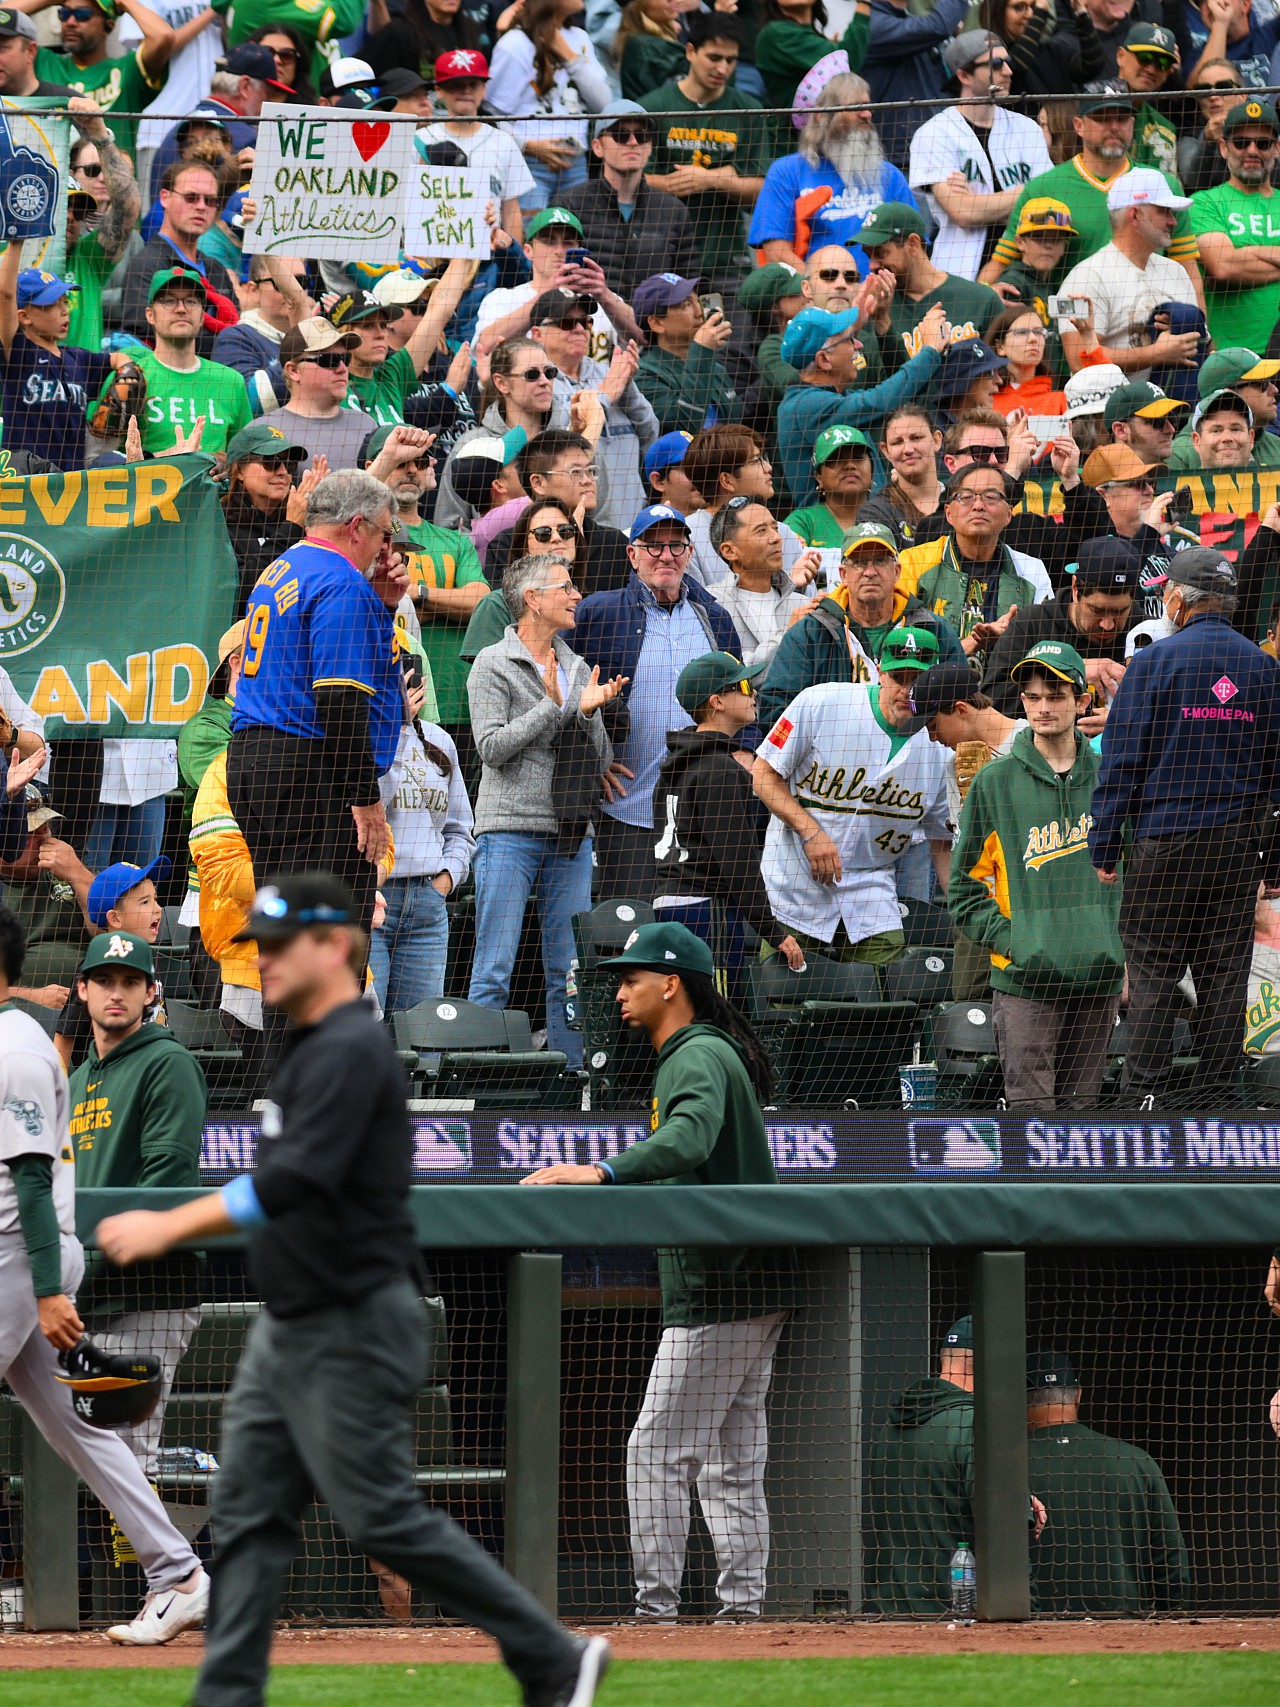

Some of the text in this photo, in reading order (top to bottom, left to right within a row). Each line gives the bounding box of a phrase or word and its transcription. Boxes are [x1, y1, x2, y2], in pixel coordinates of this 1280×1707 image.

[276, 111, 328, 160] WE
[275, 166, 400, 199] OAKLAND
[420, 172, 474, 200] SELL
[255, 194, 398, 237] Athletics
[435, 200, 457, 219] the
[422, 216, 475, 250] TEAM
[147, 396, 224, 425] SELL
[1181, 707, 1233, 721] T-MOBILE
[795, 760, 925, 809] Athletics
[874, 829, 911, 854] 43
[1026, 1118, 1173, 1168] SEATTLE
